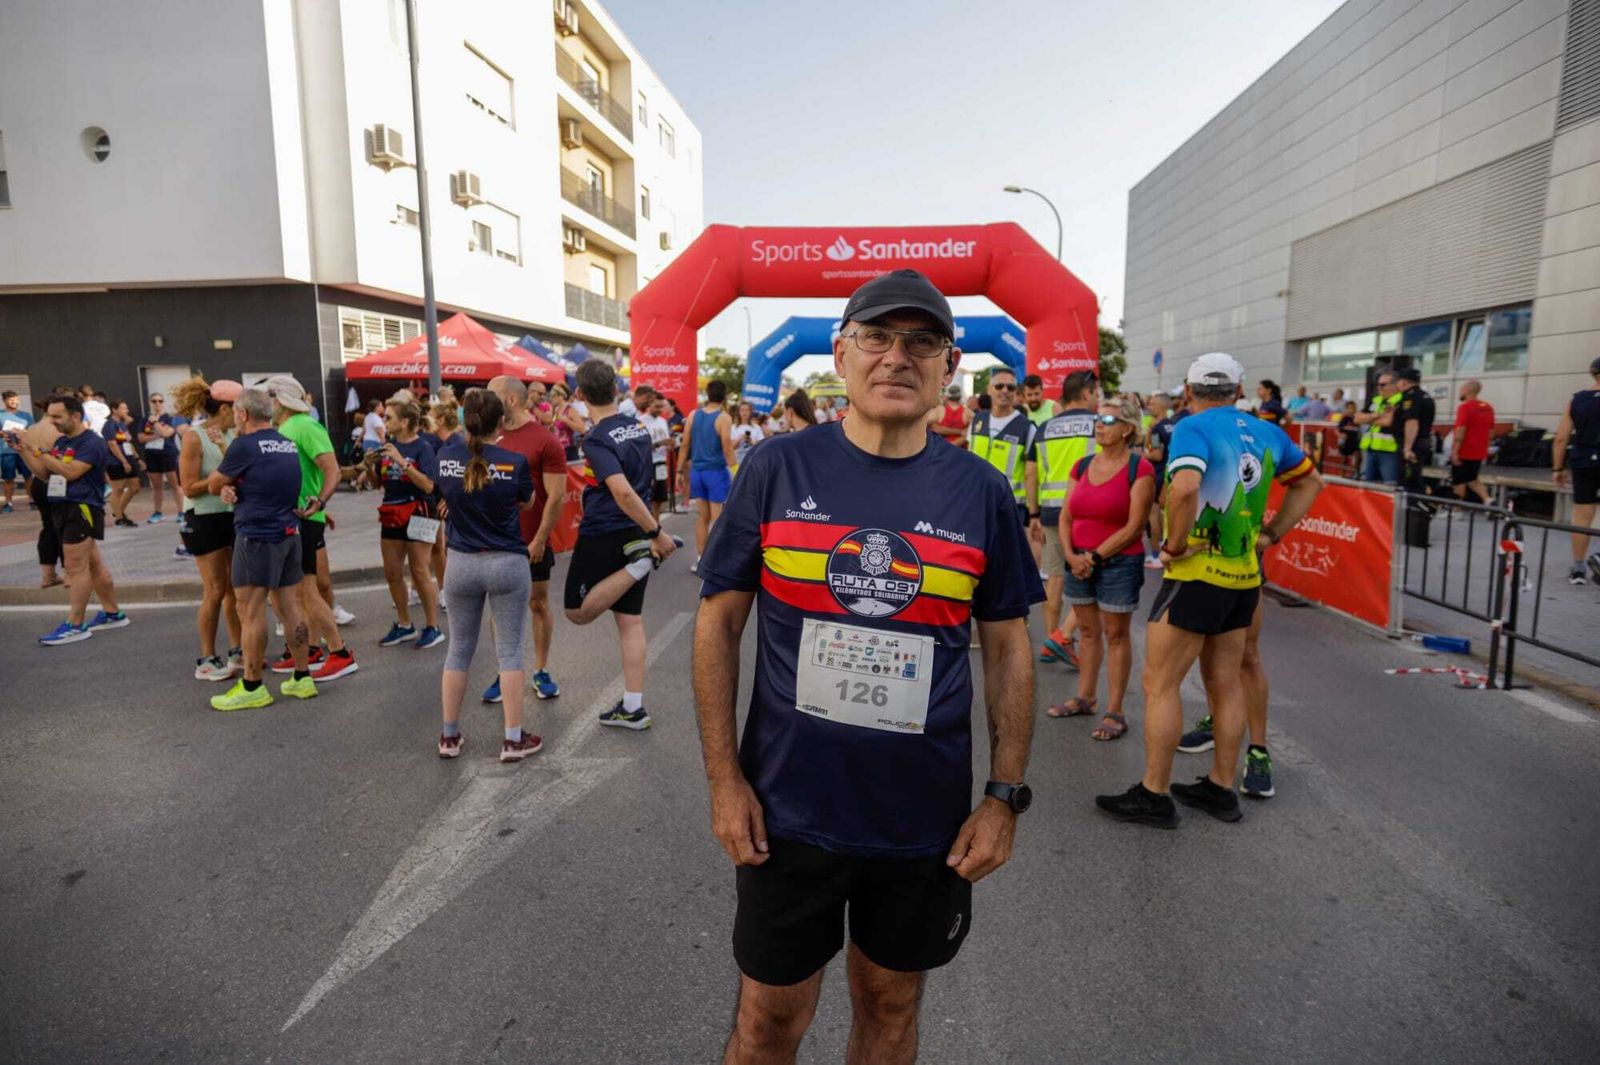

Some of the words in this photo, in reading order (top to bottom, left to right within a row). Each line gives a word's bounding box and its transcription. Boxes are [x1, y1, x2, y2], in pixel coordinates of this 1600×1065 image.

[752, 240, 823, 267] Sports
[858, 238, 976, 260] Santander
[643, 345, 676, 358] Sports
[370, 362, 476, 375] mscbike.com
[641, 362, 689, 374] Santander
[1046, 423, 1090, 435] POLICIA
[440, 460, 497, 471] POLA
[440, 469, 512, 480] NACAL
[786, 509, 831, 521] Santander
[1300, 515, 1360, 542] Santander
[936, 529, 966, 543] mupol
[831, 575, 877, 589] RUTA
[885, 581, 915, 594] 091
[874, 590, 909, 601] SOLIDARIOS
[836, 679, 888, 707] 126
